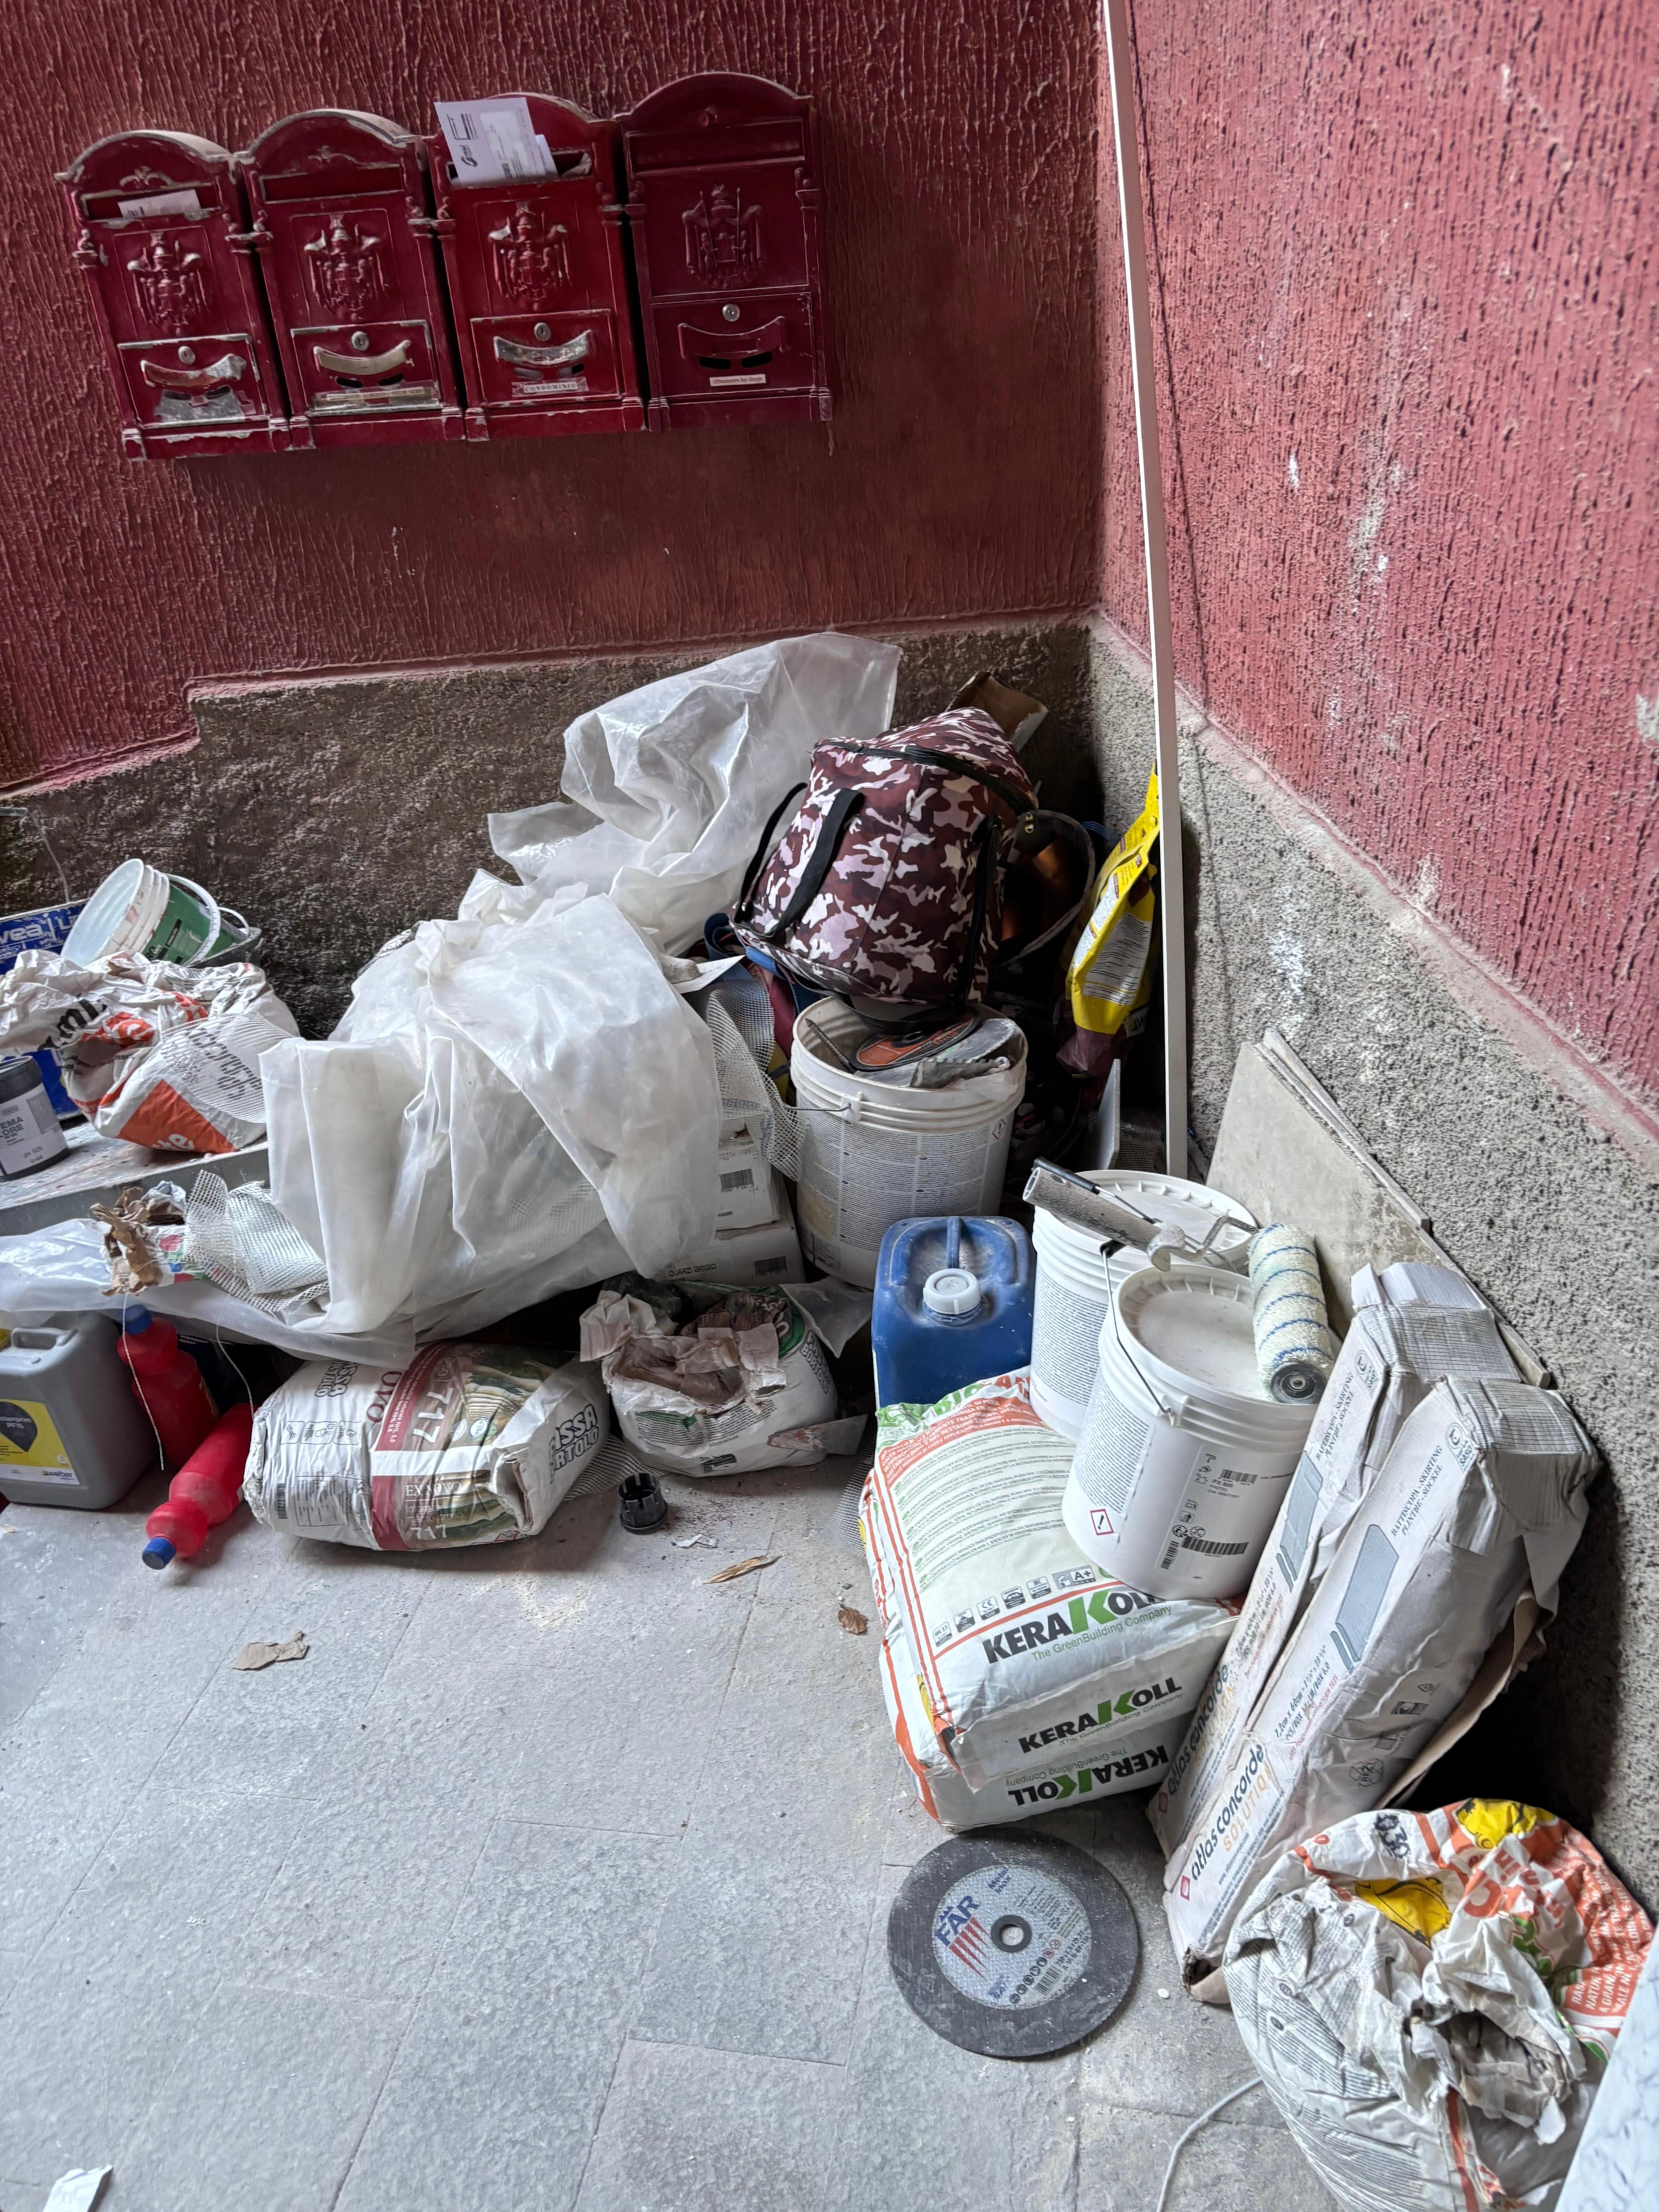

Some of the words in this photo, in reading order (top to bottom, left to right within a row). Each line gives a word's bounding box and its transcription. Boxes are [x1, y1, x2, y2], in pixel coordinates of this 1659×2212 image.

[0, 1117, 23, 1129] EMA
[366, 1370, 403, 1423] OVO
[412, 1387, 454, 1443] 717
[410, 1524, 447, 1539] 717
[1074, 1570, 1092, 1580] A+
[1031, 1649, 1051, 1661] The
[1053, 1622, 1124, 1653] GreenBuilding
[1125, 1606, 1172, 1626] Company
[1018, 1677, 1182, 1753] KERAKOLL
[1060, 1736, 1078, 1746] The
[1079, 1711, 1140, 1738] GreenBuilding
[1142, 1693, 1184, 1713] Company
[1168, 1746, 1191, 1796] atlas
[1189, 1664, 1229, 1746] concorde
[1008, 1745, 1169, 1806] KERAKOLL
[1048, 1753, 1109, 1775] GreenBuilding
[1110, 1747, 1128, 1756] The
[1006, 1771, 1047, 1786] Company
[1191, 1828, 1218, 1881] atlas
[1217, 1743, 1264, 1834] concorde
[986, 1866, 1009, 1889] Metal
[935, 1895, 981, 1947] FAR
